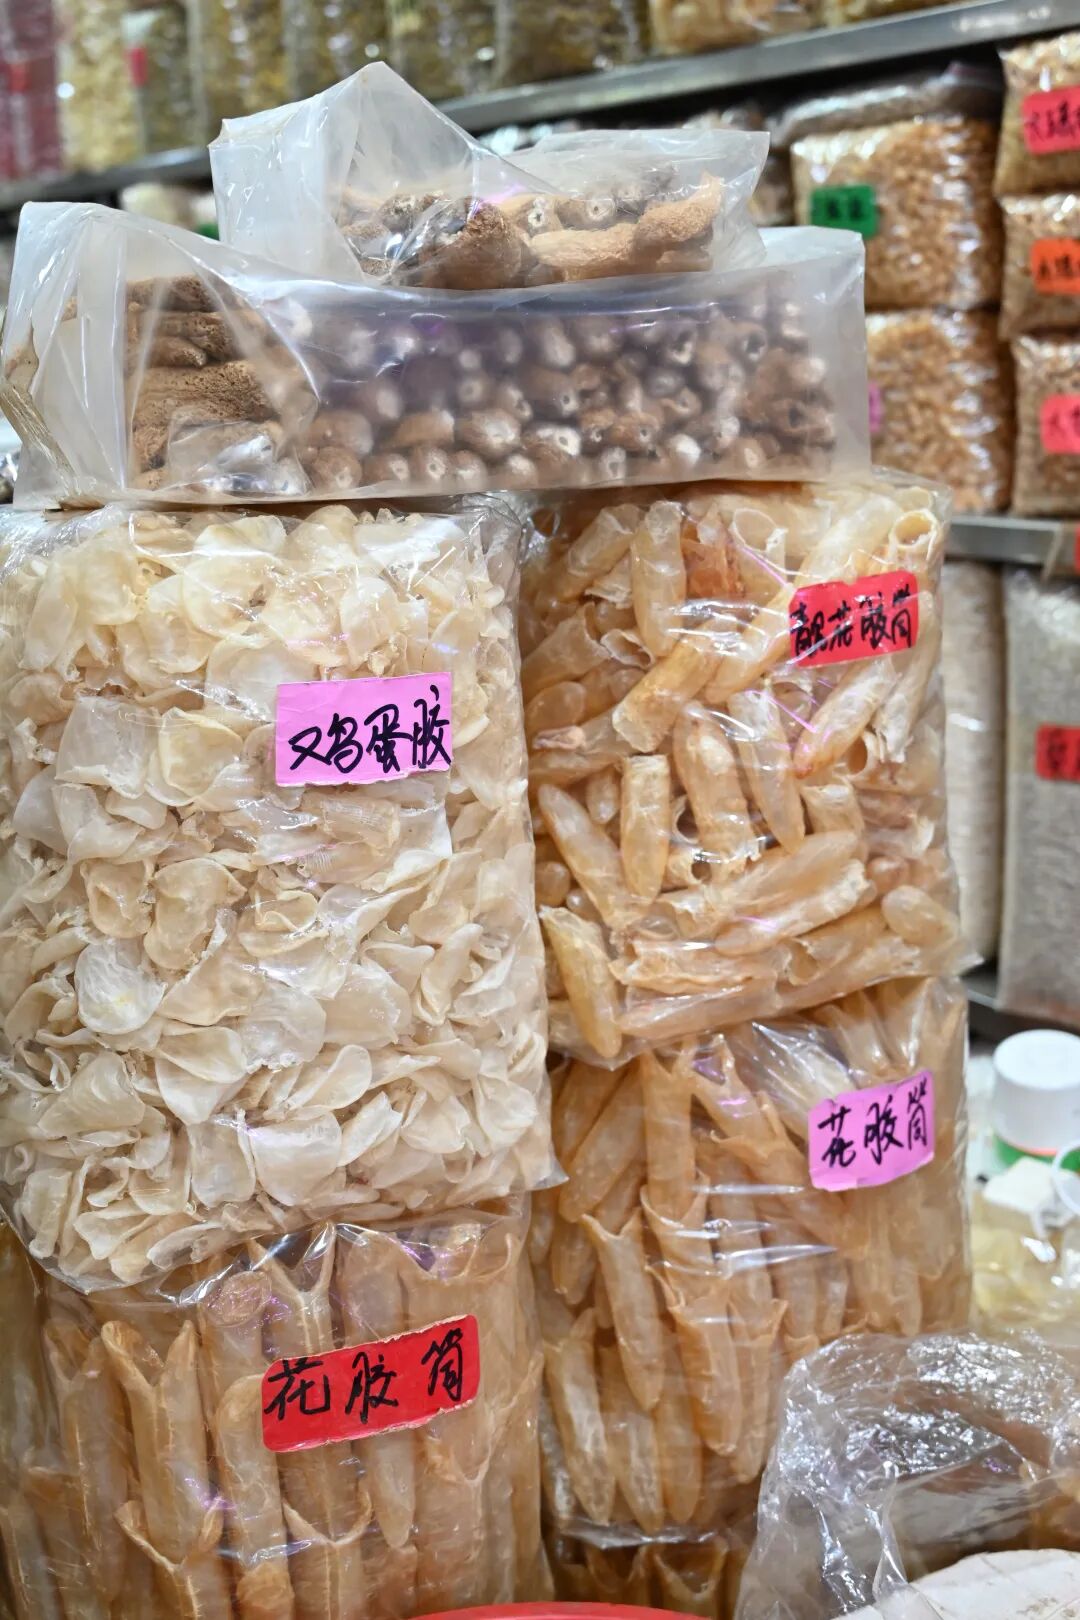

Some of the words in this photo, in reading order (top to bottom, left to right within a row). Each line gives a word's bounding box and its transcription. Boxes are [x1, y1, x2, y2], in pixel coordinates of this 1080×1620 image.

[817, 1077, 928, 1168] 花胶筒
[264, 1327, 463, 1425] 花胶筒
